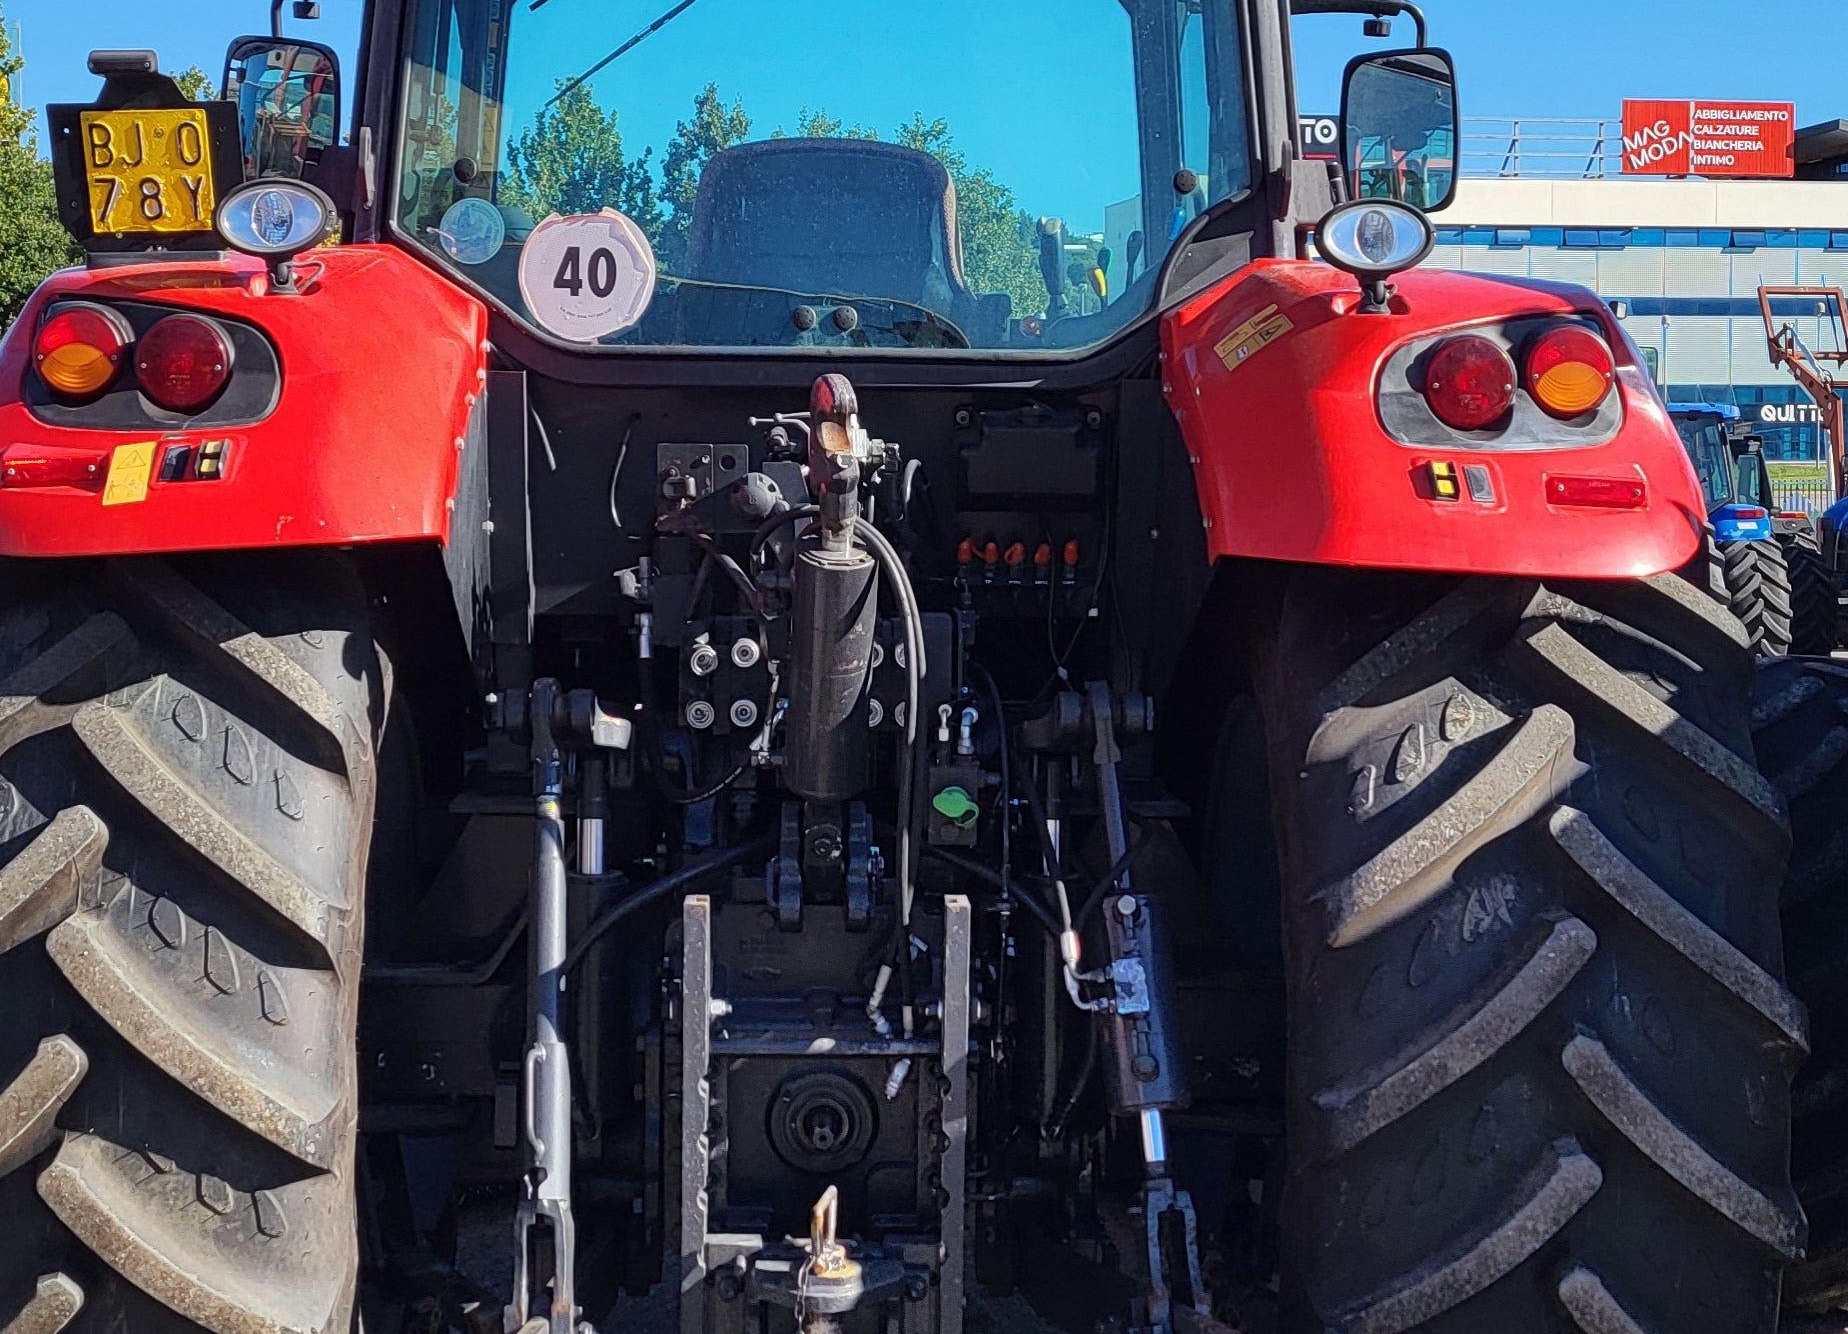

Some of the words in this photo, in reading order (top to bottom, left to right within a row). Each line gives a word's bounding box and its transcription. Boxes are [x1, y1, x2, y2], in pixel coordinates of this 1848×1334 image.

[1693, 109, 1789, 121] ABBIGLIAMENTO
[1623, 120, 1671, 152] MAG
[1693, 124, 1760, 136] CALZATURE
[1629, 131, 1693, 170] MODA
[1693, 140, 1764, 151] BIANCHERIA
[1693, 154, 1735, 166] INTIMO
[553, 246, 617, 298] 40
